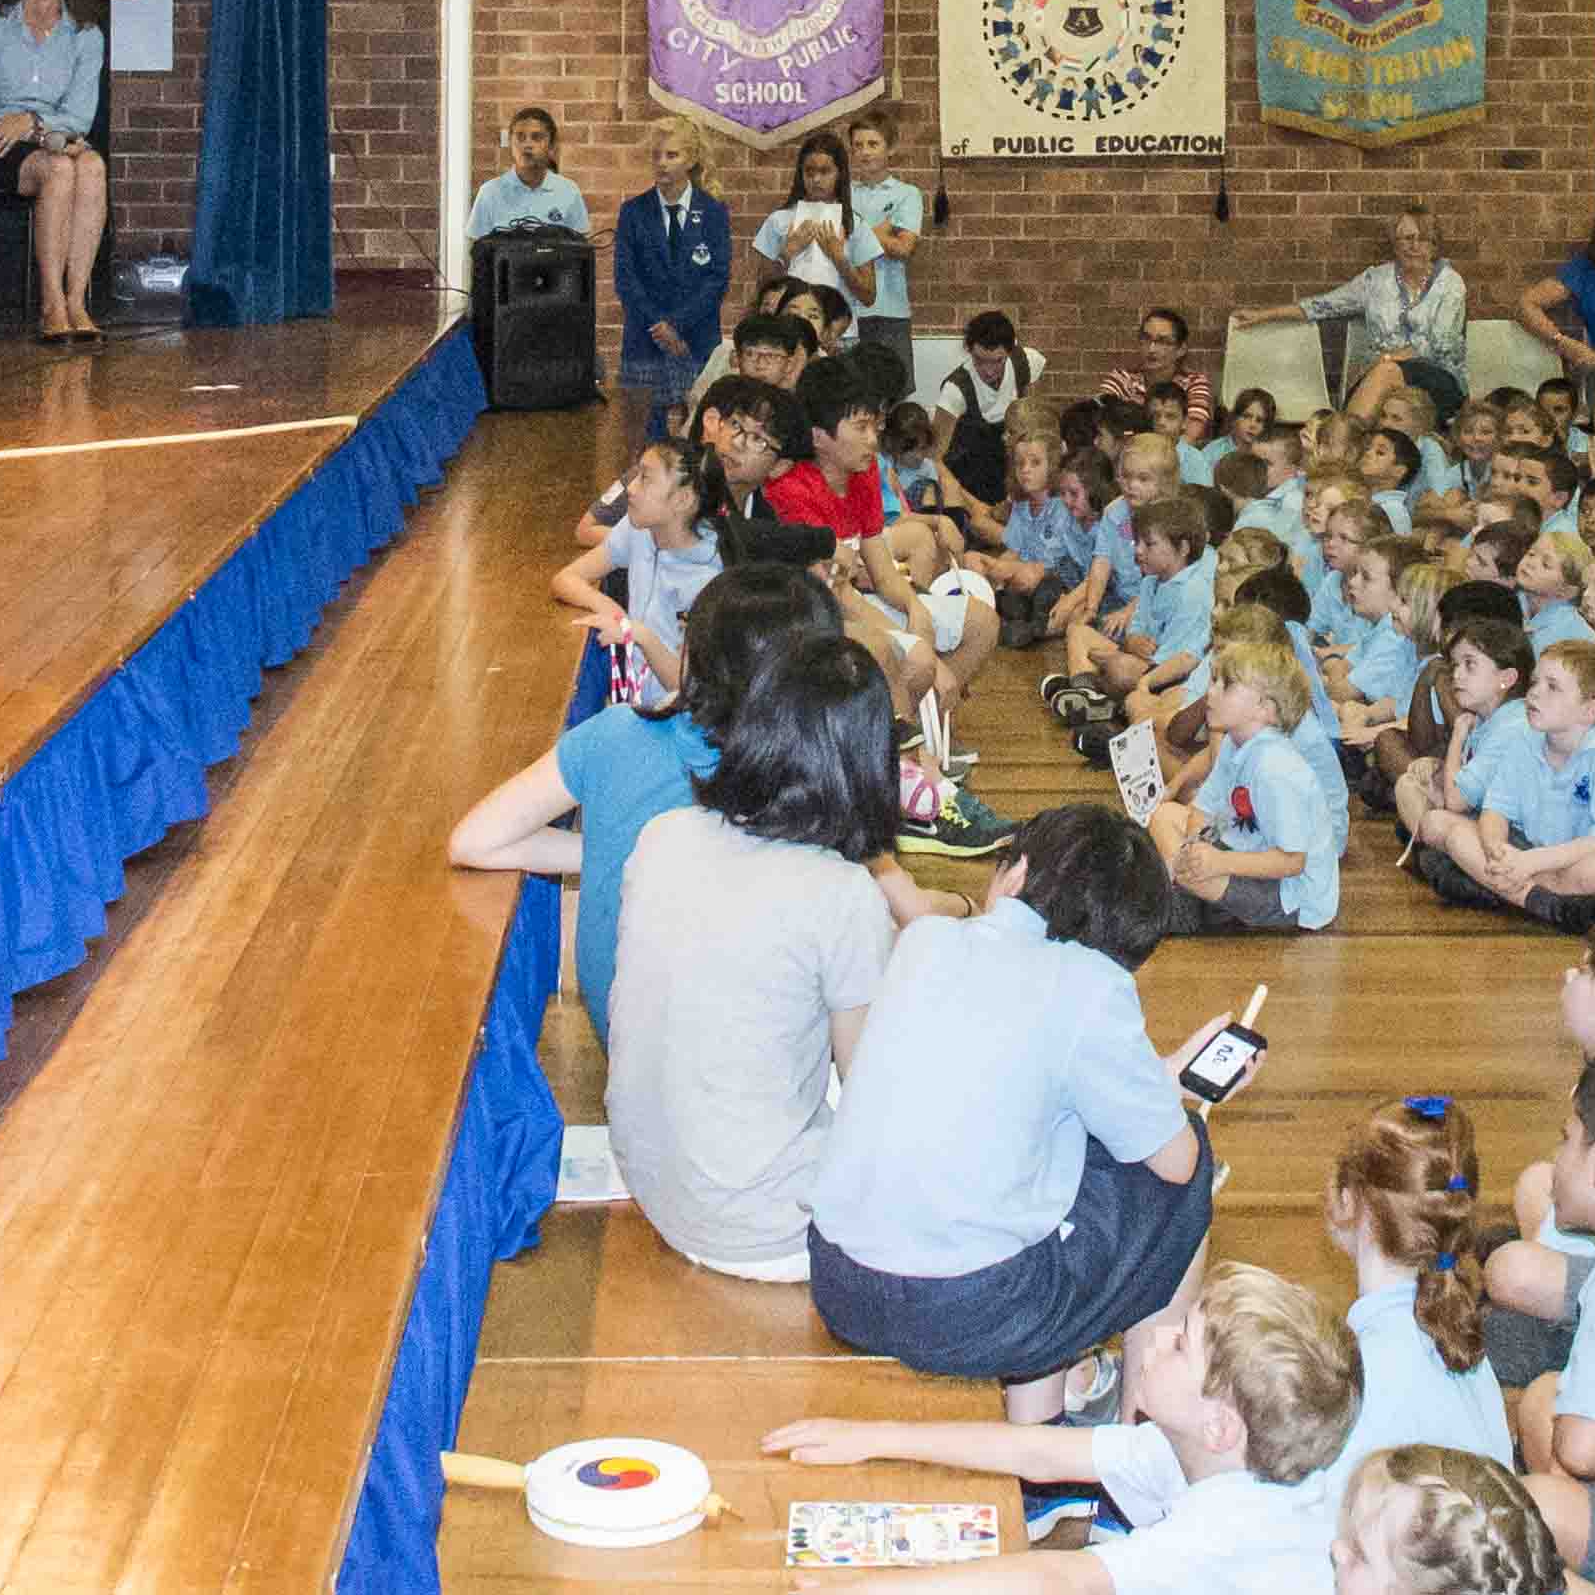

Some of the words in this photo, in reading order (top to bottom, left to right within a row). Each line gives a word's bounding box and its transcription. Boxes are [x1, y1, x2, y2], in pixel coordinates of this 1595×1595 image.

[667, 26, 744, 72] CITY
[776, 24, 859, 79] PUBLIC
[715, 80, 807, 104] SCHOOL
[950, 138, 970, 155] of
[992, 136, 1075, 154] PUBLIC
[1095, 135, 1223, 154] EDUCATION
